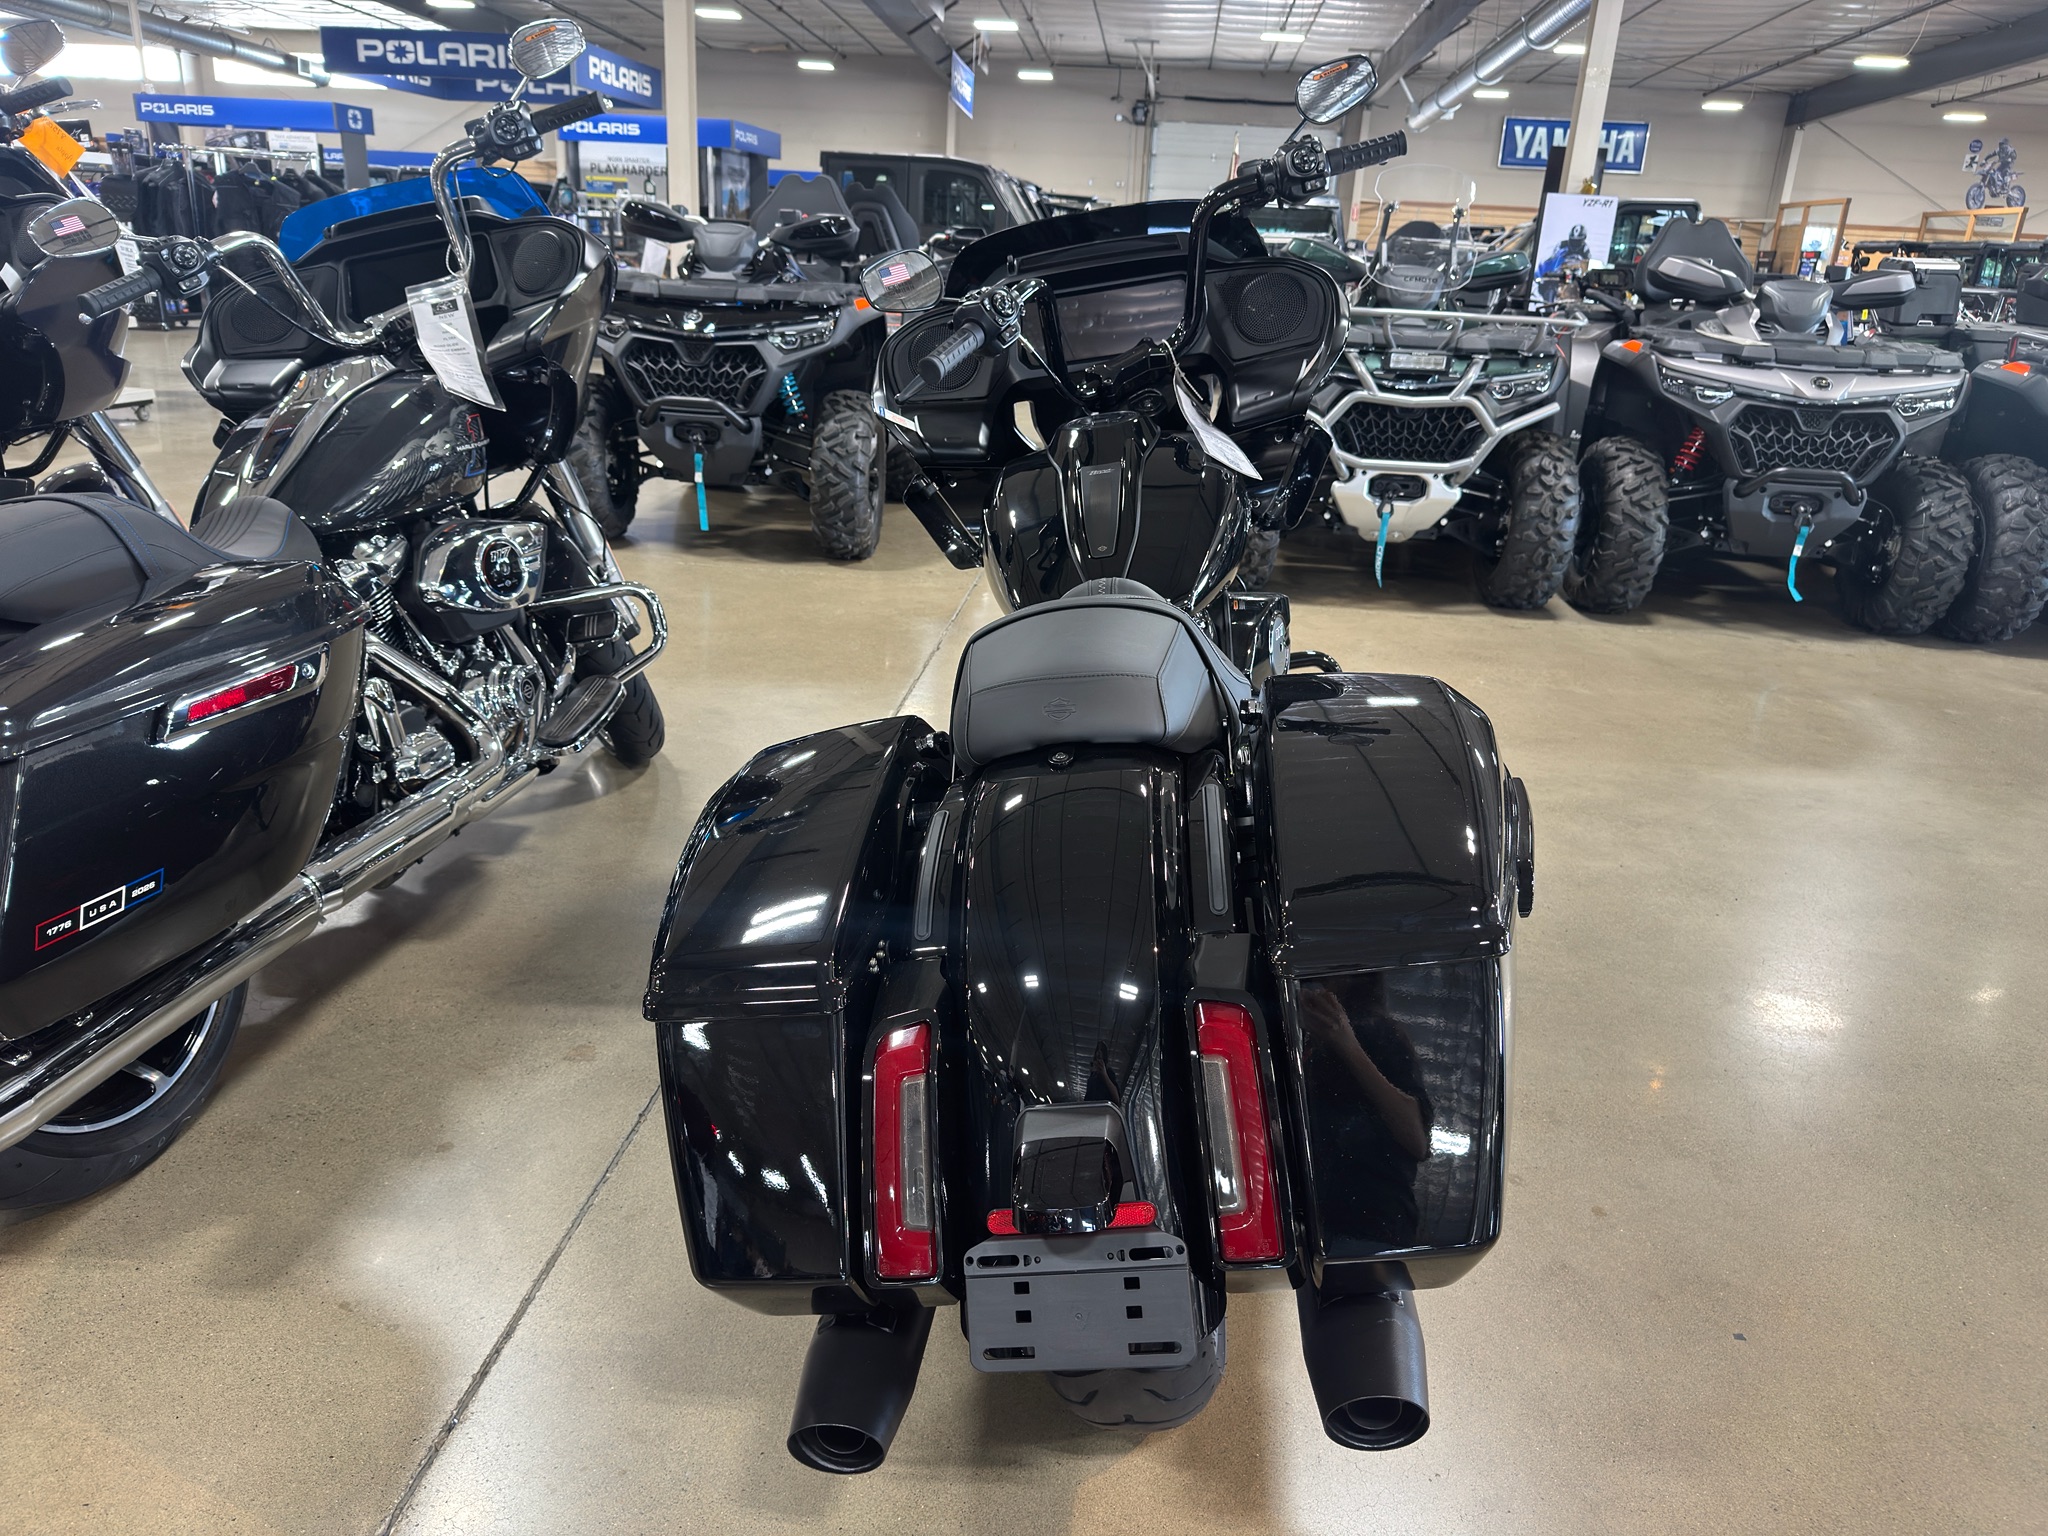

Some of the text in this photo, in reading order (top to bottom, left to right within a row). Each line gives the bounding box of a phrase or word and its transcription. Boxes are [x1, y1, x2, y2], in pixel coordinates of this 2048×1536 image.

[356, 38, 513, 70] POLARI
[588, 54, 653, 97] POLARIS
[140, 102, 215, 116] POLARIS
[1514, 125, 1635, 164] YAHA
[590, 162, 618, 174] PLAY
[1582, 198, 1615, 208] YZF-R1
[46, 920, 72, 937] 1776
[131, 881, 156, 898] 2026
